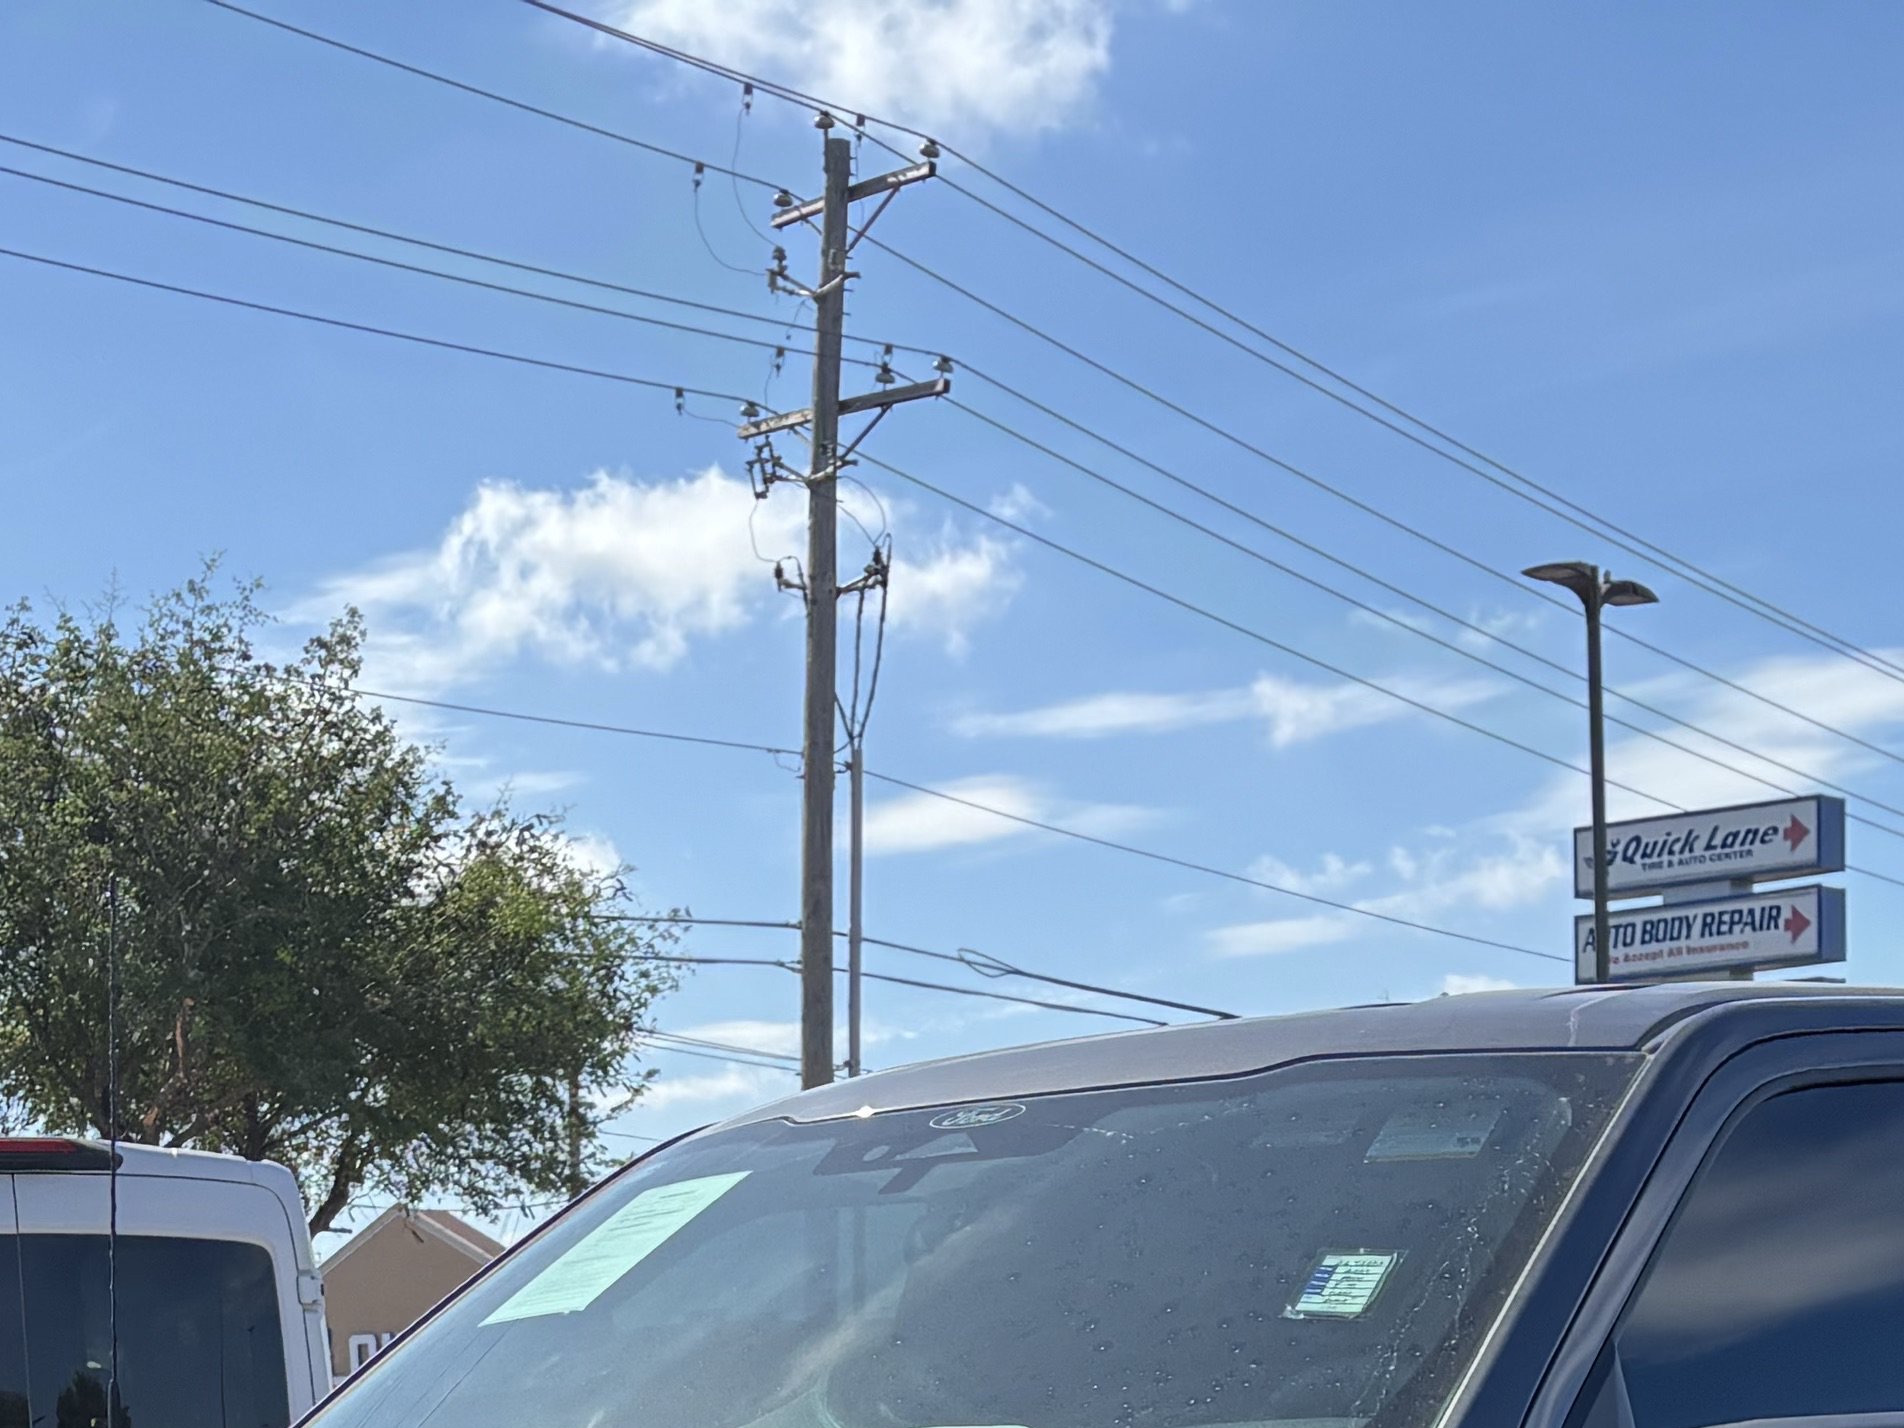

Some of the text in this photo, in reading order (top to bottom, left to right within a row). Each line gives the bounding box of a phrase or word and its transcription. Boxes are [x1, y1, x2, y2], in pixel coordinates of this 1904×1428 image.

[1621, 824, 1780, 865] Quick Lane
[1677, 854, 1707, 867] AUTO
[1709, 849, 1754, 863] CENTER
[1582, 904, 1782, 953] ATO BODY REPAIR
